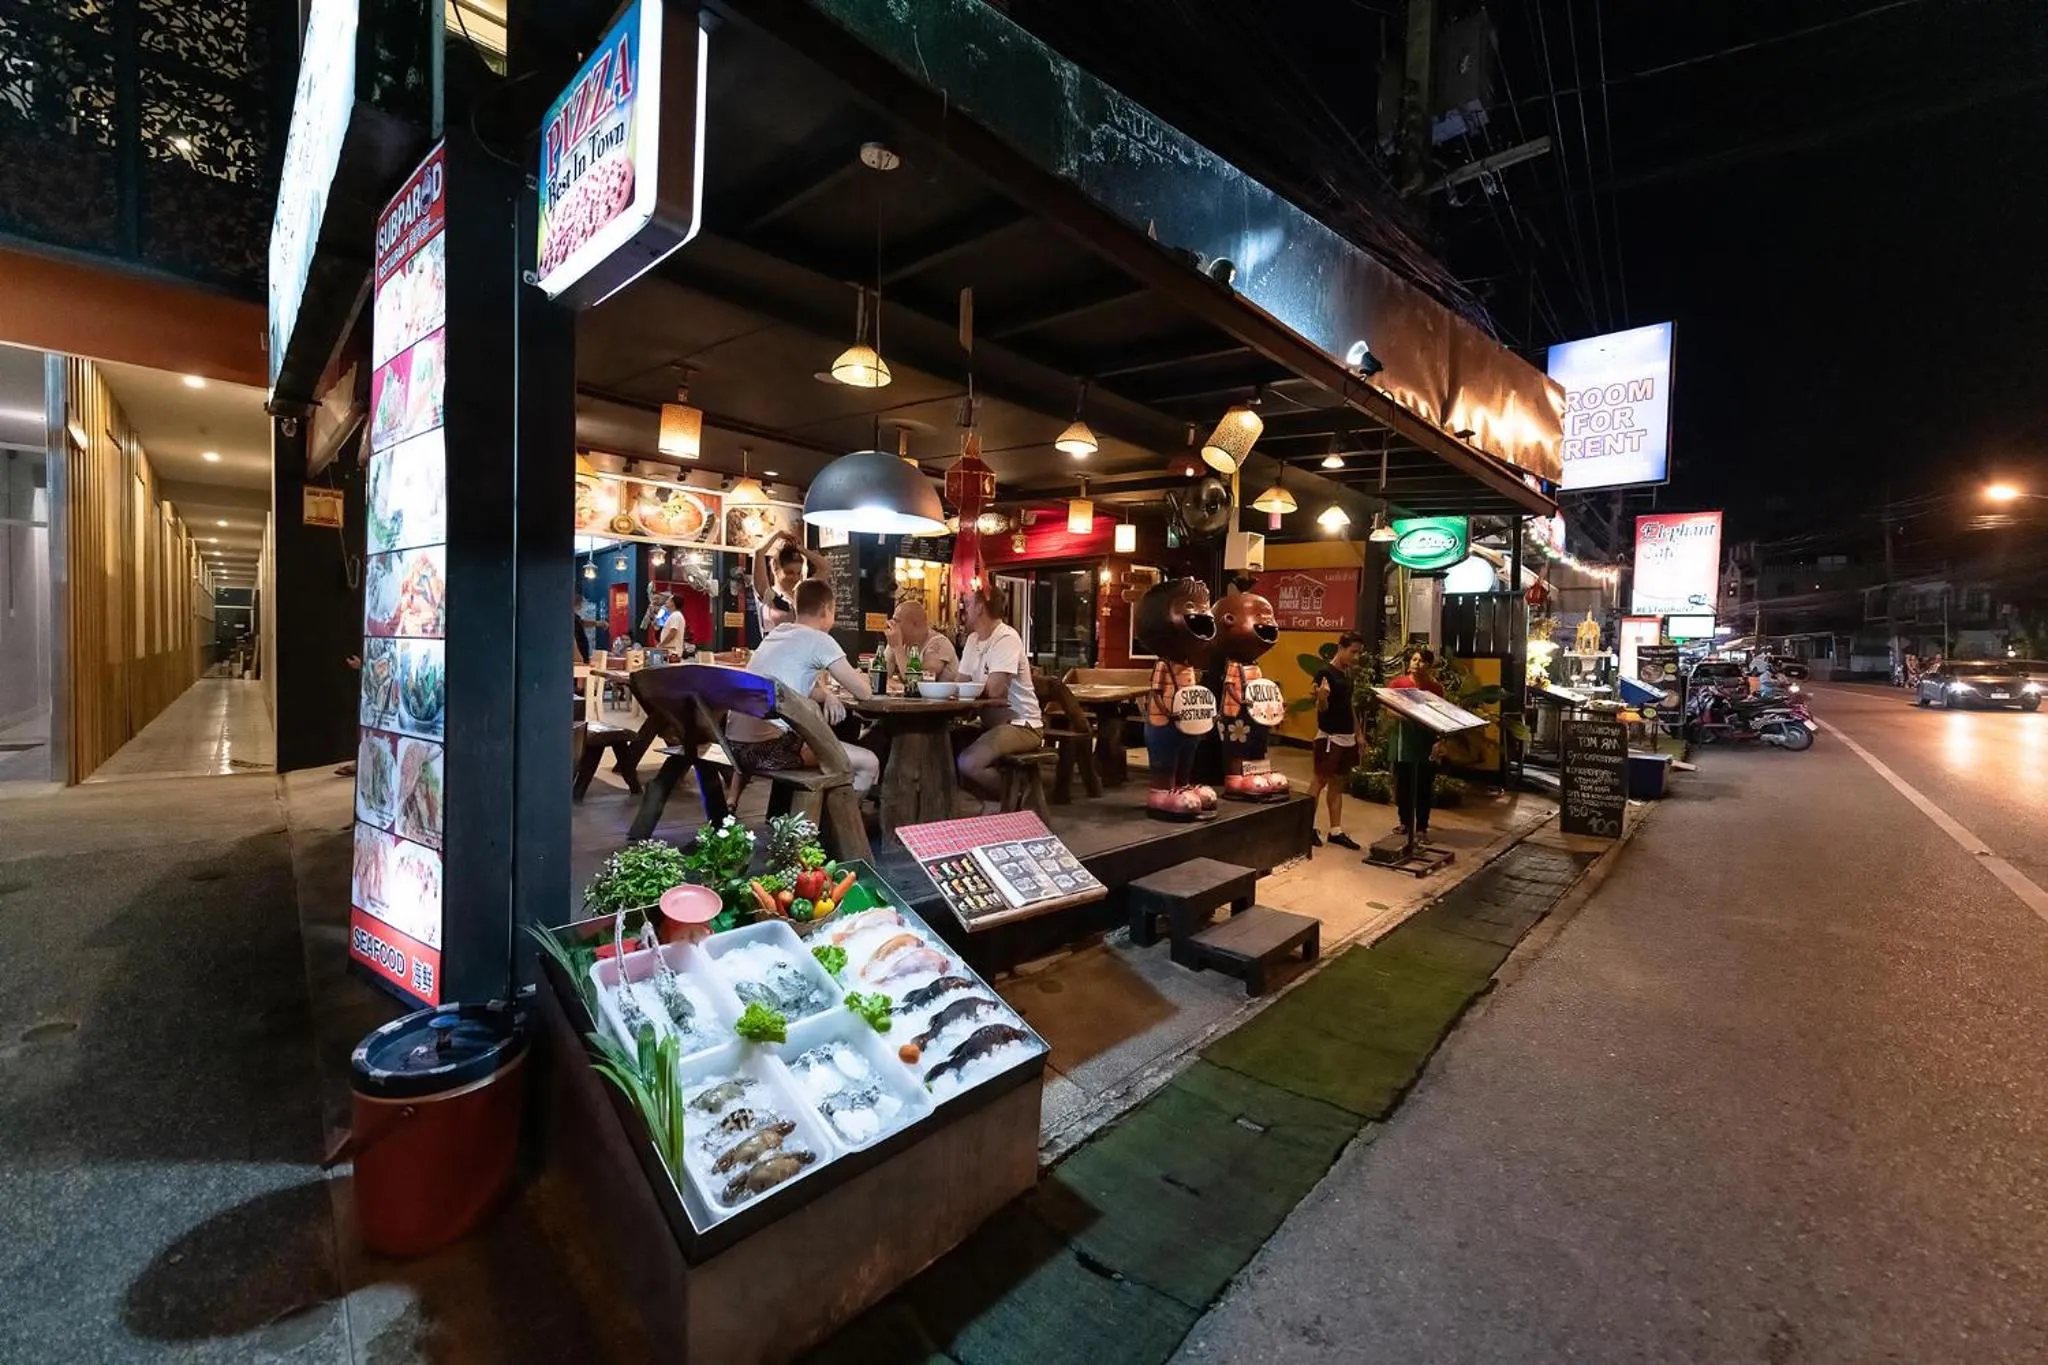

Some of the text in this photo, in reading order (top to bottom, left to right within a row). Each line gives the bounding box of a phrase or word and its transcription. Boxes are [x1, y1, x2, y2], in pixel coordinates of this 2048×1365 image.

[546, 33, 633, 181] PIZZA
[548, 121, 624, 210] Best In Town
[1565, 378, 1654, 414] ROOM
[1572, 407, 1635, 436] FOR
[1563, 429, 1648, 461] RENT
[1641, 523, 1715, 542] Elephant
[1292, 616, 1310, 628] For
[1315, 616, 1344, 628] Rent
[1180, 707, 1214, 721] RESTAURANT
[354, 926, 406, 977] SEAFOOD
